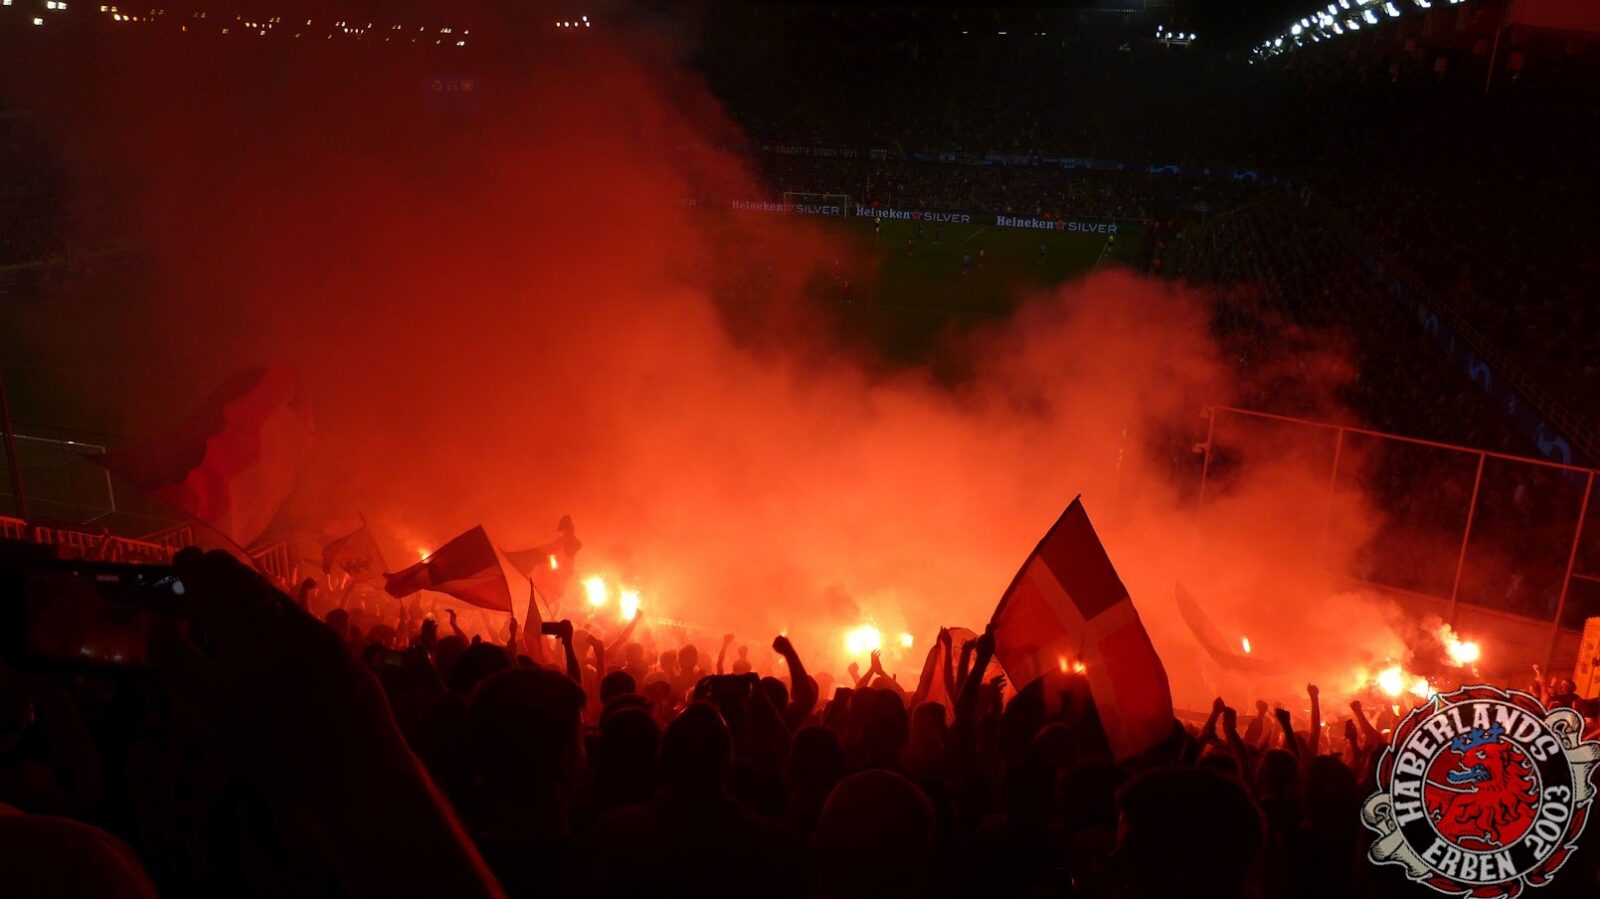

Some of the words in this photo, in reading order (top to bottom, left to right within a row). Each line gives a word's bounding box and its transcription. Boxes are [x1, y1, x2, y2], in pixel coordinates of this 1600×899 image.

[732, 199, 784, 212] Heineken
[796, 203, 840, 215] SILVER
[855, 205, 911, 220] Heineken
[924, 212, 971, 223] SILVER
[996, 215, 1054, 230] Heineken
[1068, 221, 1118, 233] SILVER
